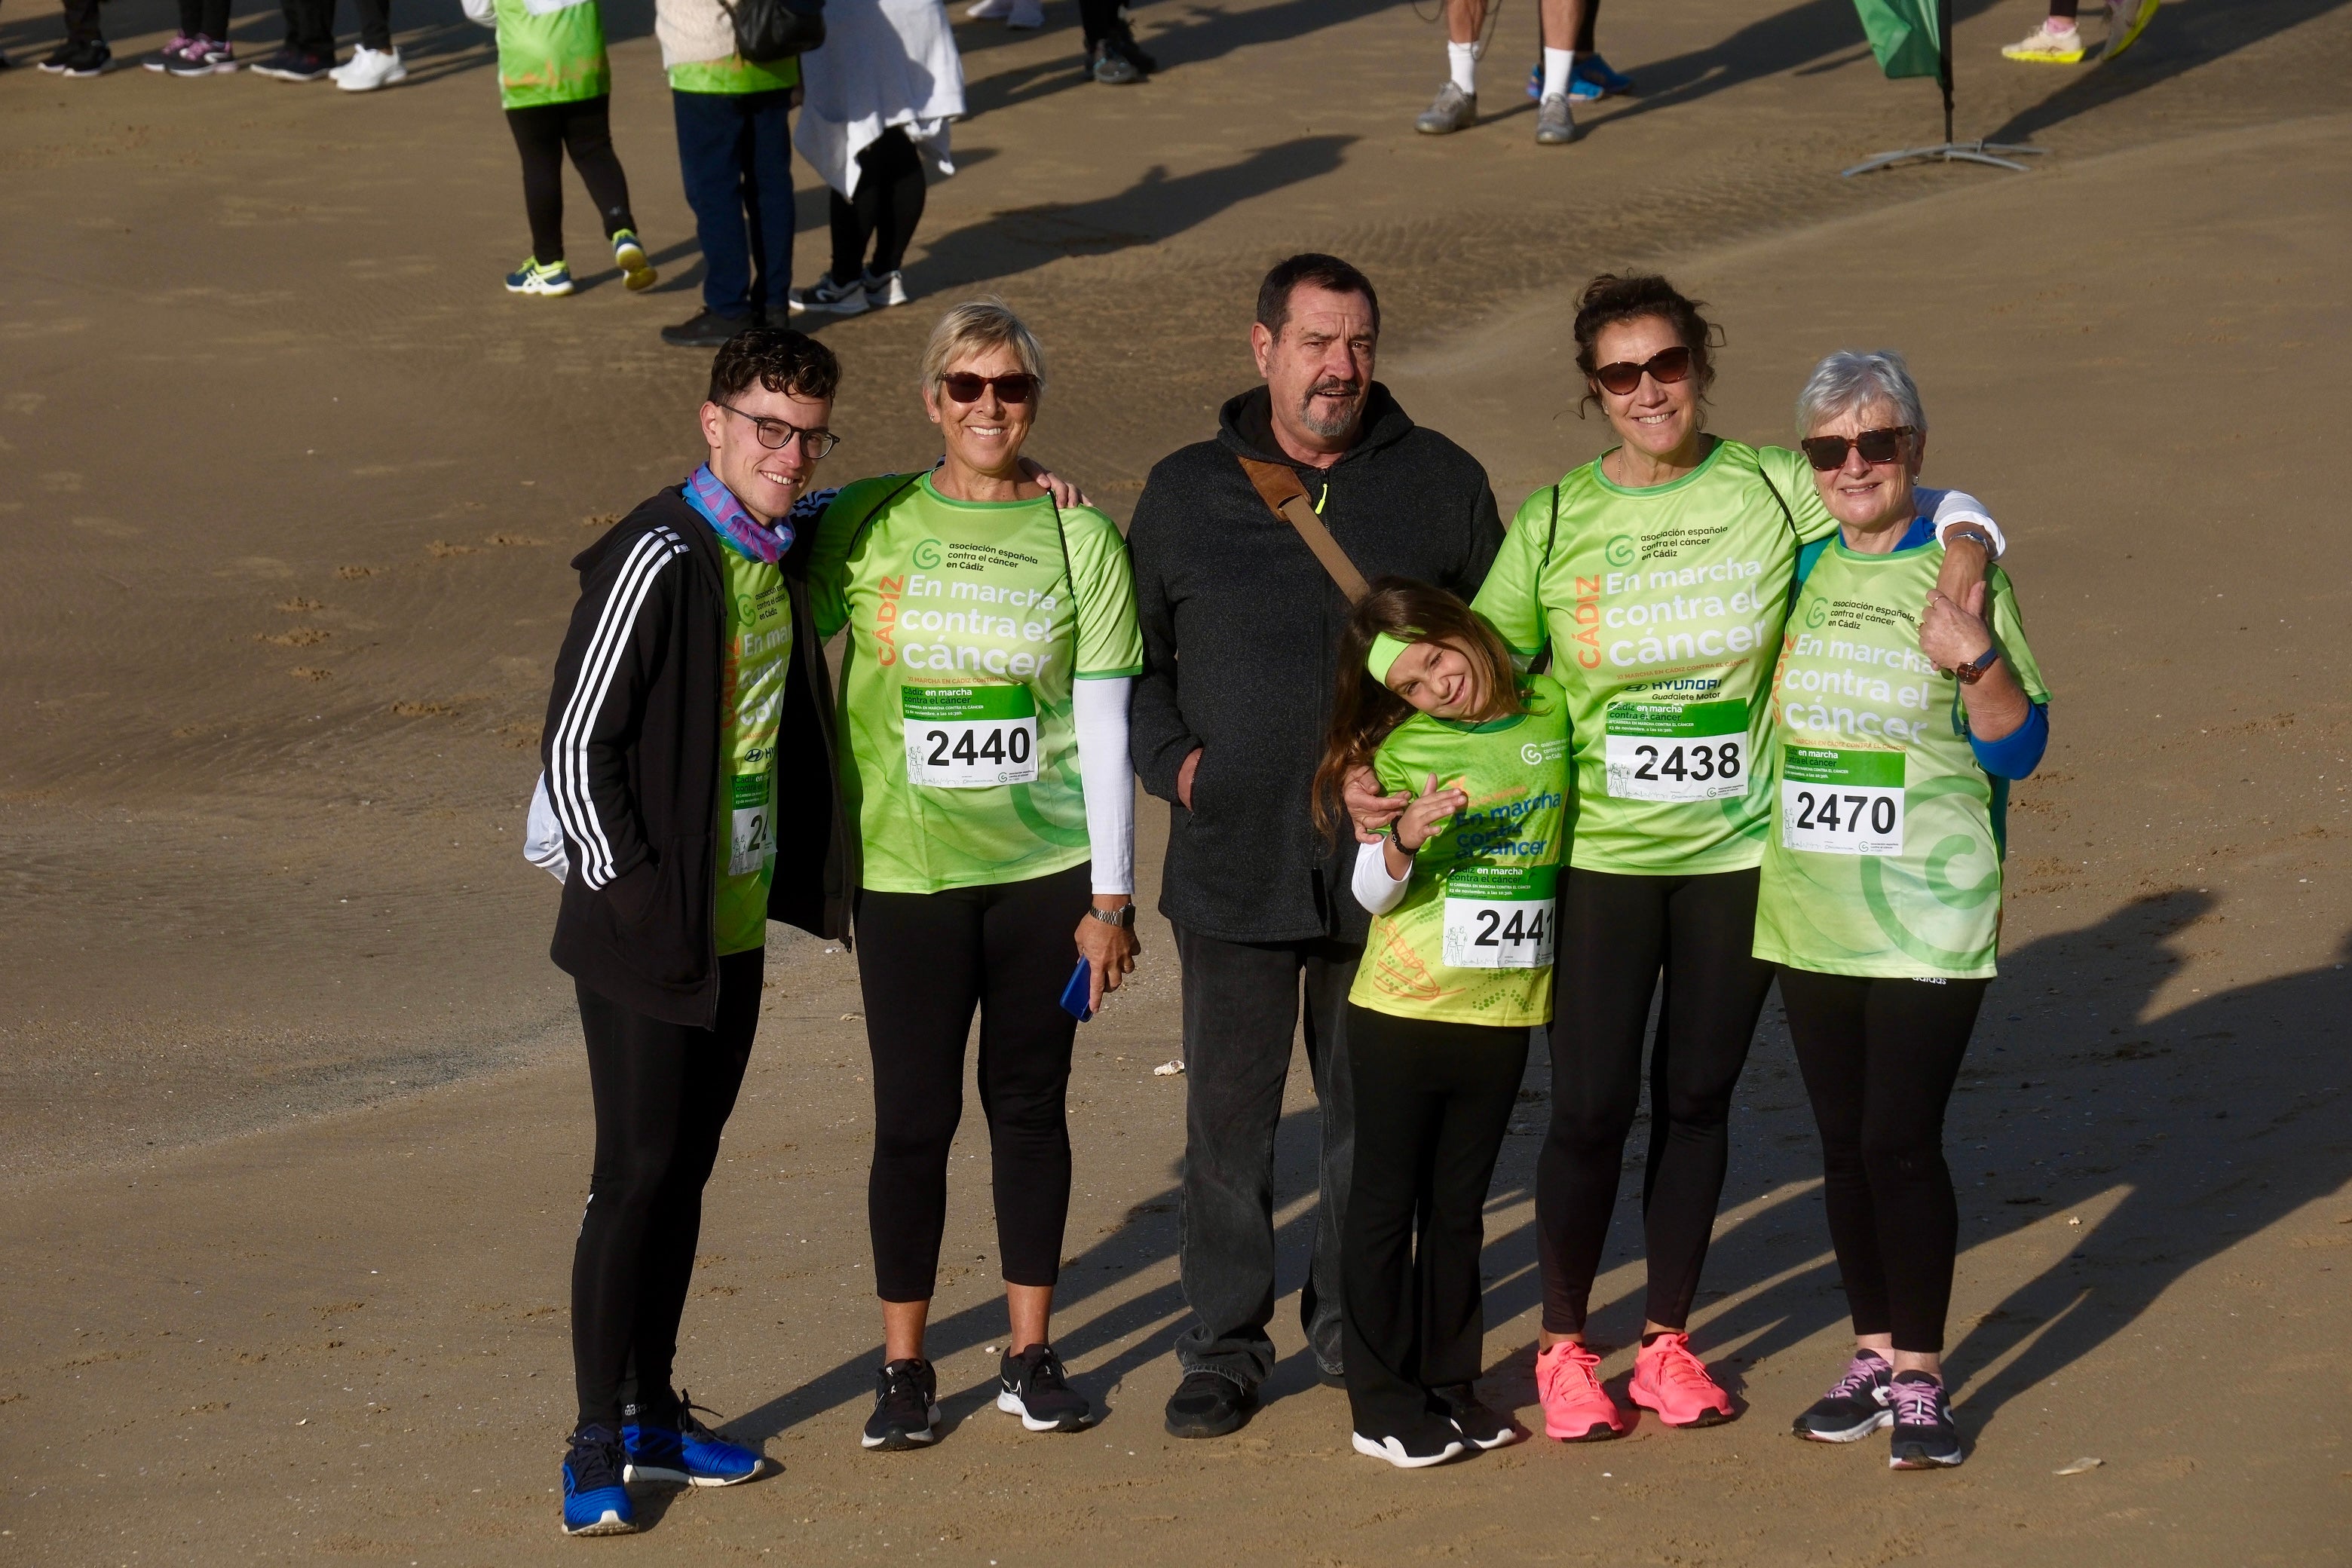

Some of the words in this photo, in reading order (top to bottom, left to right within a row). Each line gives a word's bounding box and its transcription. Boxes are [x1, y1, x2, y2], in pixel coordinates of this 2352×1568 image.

[1641, 529, 1686, 542] asociación
[1688, 526, 1729, 536] española
[1642, 541, 1668, 552] contra
[1680, 537, 1710, 547] cáncer
[948, 552, 976, 562] contra
[988, 556, 1018, 568] cáncer
[949, 543, 997, 553] asociación
[998, 550, 1038, 565] española
[1653, 550, 1677, 558] Cádiz
[959, 562, 984, 571] Cádiz
[1606, 572, 1640, 595] En
[1650, 556, 1762, 589] marcha
[907, 574, 942, 596] En
[951, 581, 1056, 612] marcha
[1606, 595, 1726, 628] contra
[1731, 583, 1762, 614] el
[1833, 600, 1873, 611] asociación
[1876, 607, 1916, 622] española
[872, 574, 904, 666] CÁDIZ
[901, 608, 1017, 639] contra
[1022, 617, 1053, 643] el
[1572, 574, 1601, 669] CÁDIZ
[1830, 609, 1854, 619] contra
[1865, 614, 1896, 626] cáncer
[1838, 620, 1861, 629] Cádiz
[744, 633, 763, 657] En
[1609, 620, 1766, 666] cáncer
[902, 635, 1052, 678] cáncer
[1795, 634, 1823, 657] En
[1829, 640, 1937, 675] marcha
[903, 687, 923, 696] Cádiz
[938, 688, 972, 696] marcha
[1652, 679, 1723, 691] HYUNDAI
[1696, 692, 1720, 700] Motor
[1784, 669, 1890, 703] contra
[1897, 681, 1929, 710] el
[904, 695, 928, 704] contra
[940, 696, 972, 704] cáncer
[1649, 705, 1683, 713] marcha
[1650, 712, 1681, 721] cáncer
[1785, 696, 1928, 744] cáncer
[926, 727, 1031, 766] 2440
[1808, 750, 1839, 759] marcha
[1634, 742, 1741, 782] 2438
[1810, 758, 1837, 767] cáncer
[1490, 790, 1561, 821] marcha
[1797, 792, 1896, 835] 2470
[1449, 874, 1478, 882] contra
[1492, 875, 1521, 884] cáncer
[1475, 907, 1554, 946] 2441
